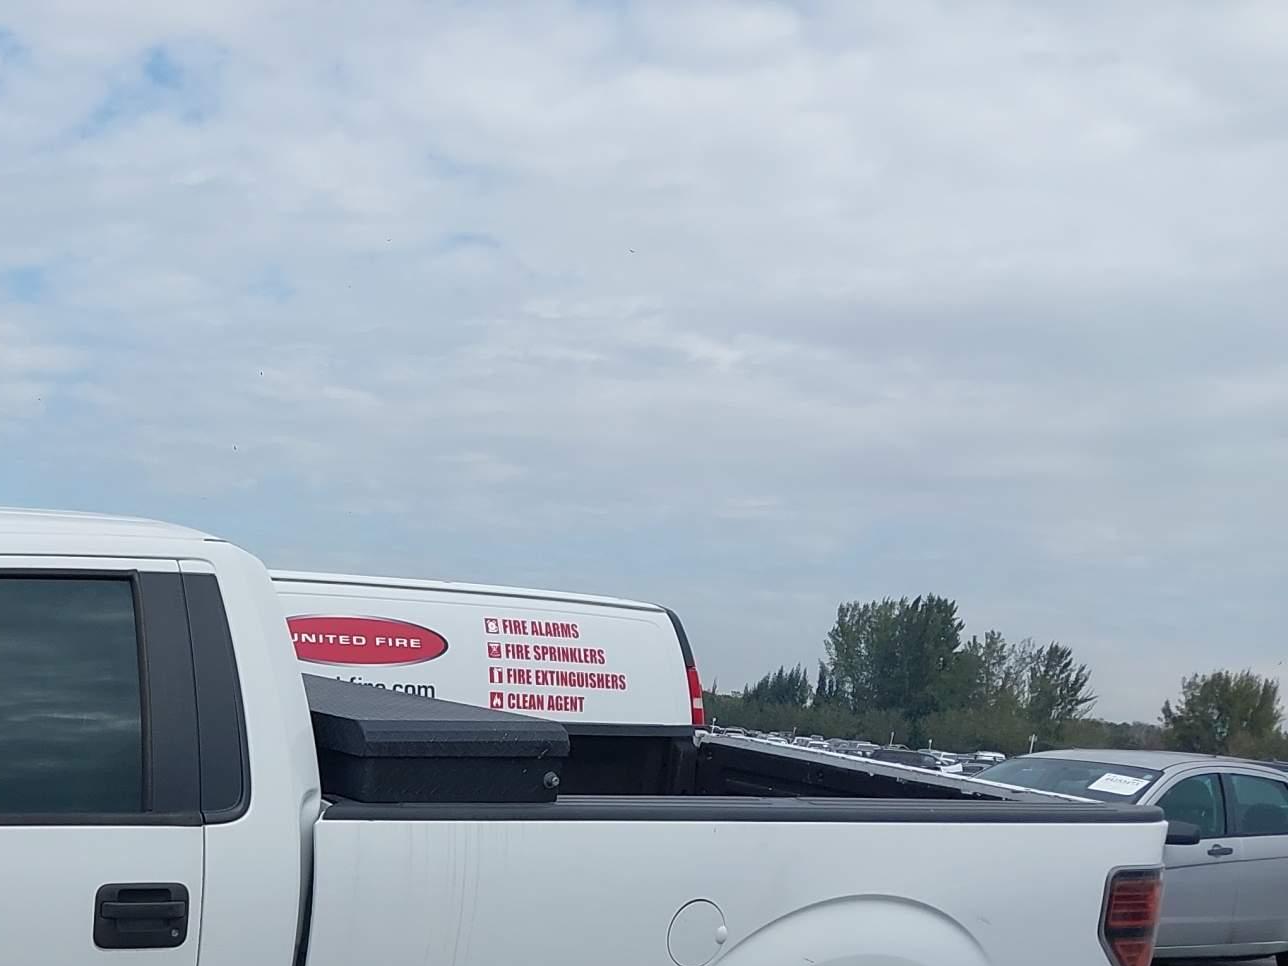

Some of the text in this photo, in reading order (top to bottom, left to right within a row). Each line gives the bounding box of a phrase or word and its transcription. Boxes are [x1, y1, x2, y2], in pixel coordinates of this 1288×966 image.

[502, 619, 579, 638] FIRE ALARMS
[376, 637, 421, 648] FIRE
[505, 643, 605, 664] FIRE SPRINKLERS
[507, 668, 626, 690] FIRE EXTINGUISHERS
[507, 693, 585, 712] CLEAN AGENT
